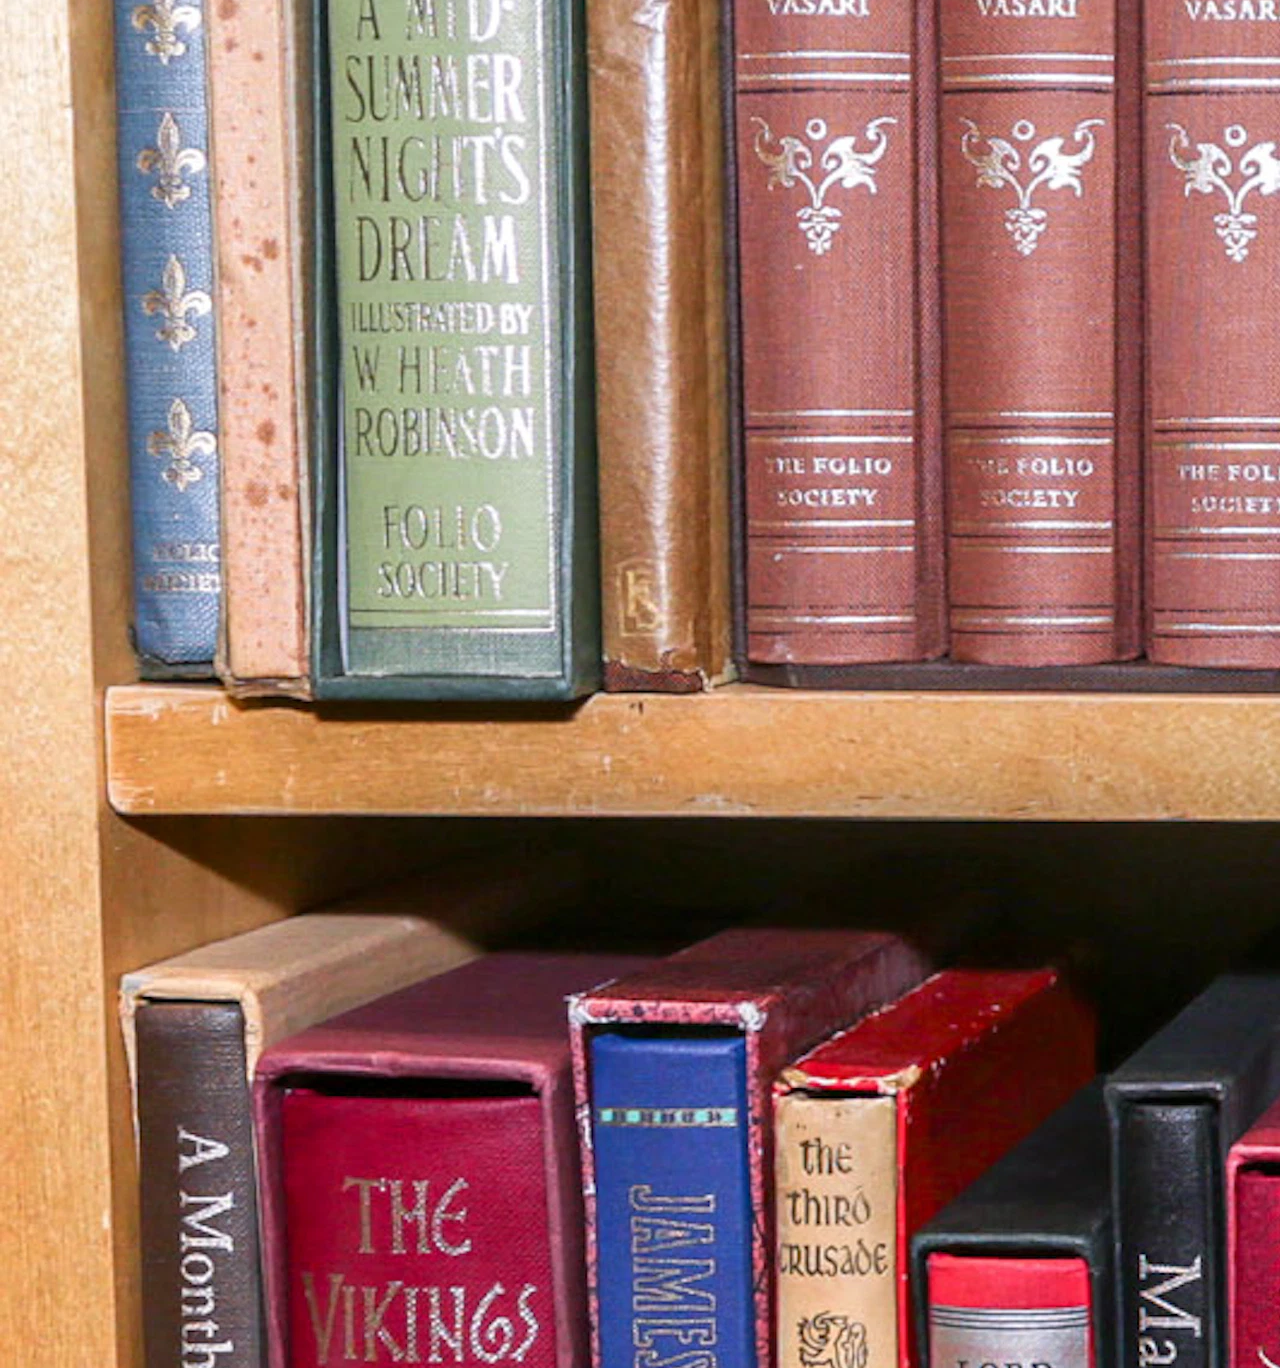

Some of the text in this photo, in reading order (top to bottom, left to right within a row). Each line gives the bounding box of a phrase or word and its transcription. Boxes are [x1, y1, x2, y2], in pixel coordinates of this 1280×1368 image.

[345, 54, 526, 124] SUMMER
[357, 218, 520, 284] DREAM
[400, 343, 532, 394] HEATH
[356, 408, 536, 458] ROBINSON
[812, 457, 892, 476] FOLIO
[1017, 458, 1093, 477] FOLIO
[777, 489, 878, 507] SOCIETY
[981, 490, 1079, 509] SOCIETY
[383, 504, 503, 549] FOLIO
[377, 561, 508, 601] SOCIETY
[178, 1127, 230, 1173] A
[342, 1178, 471, 1256] THE
[303, 1272, 539, 1365] VIKINGS
